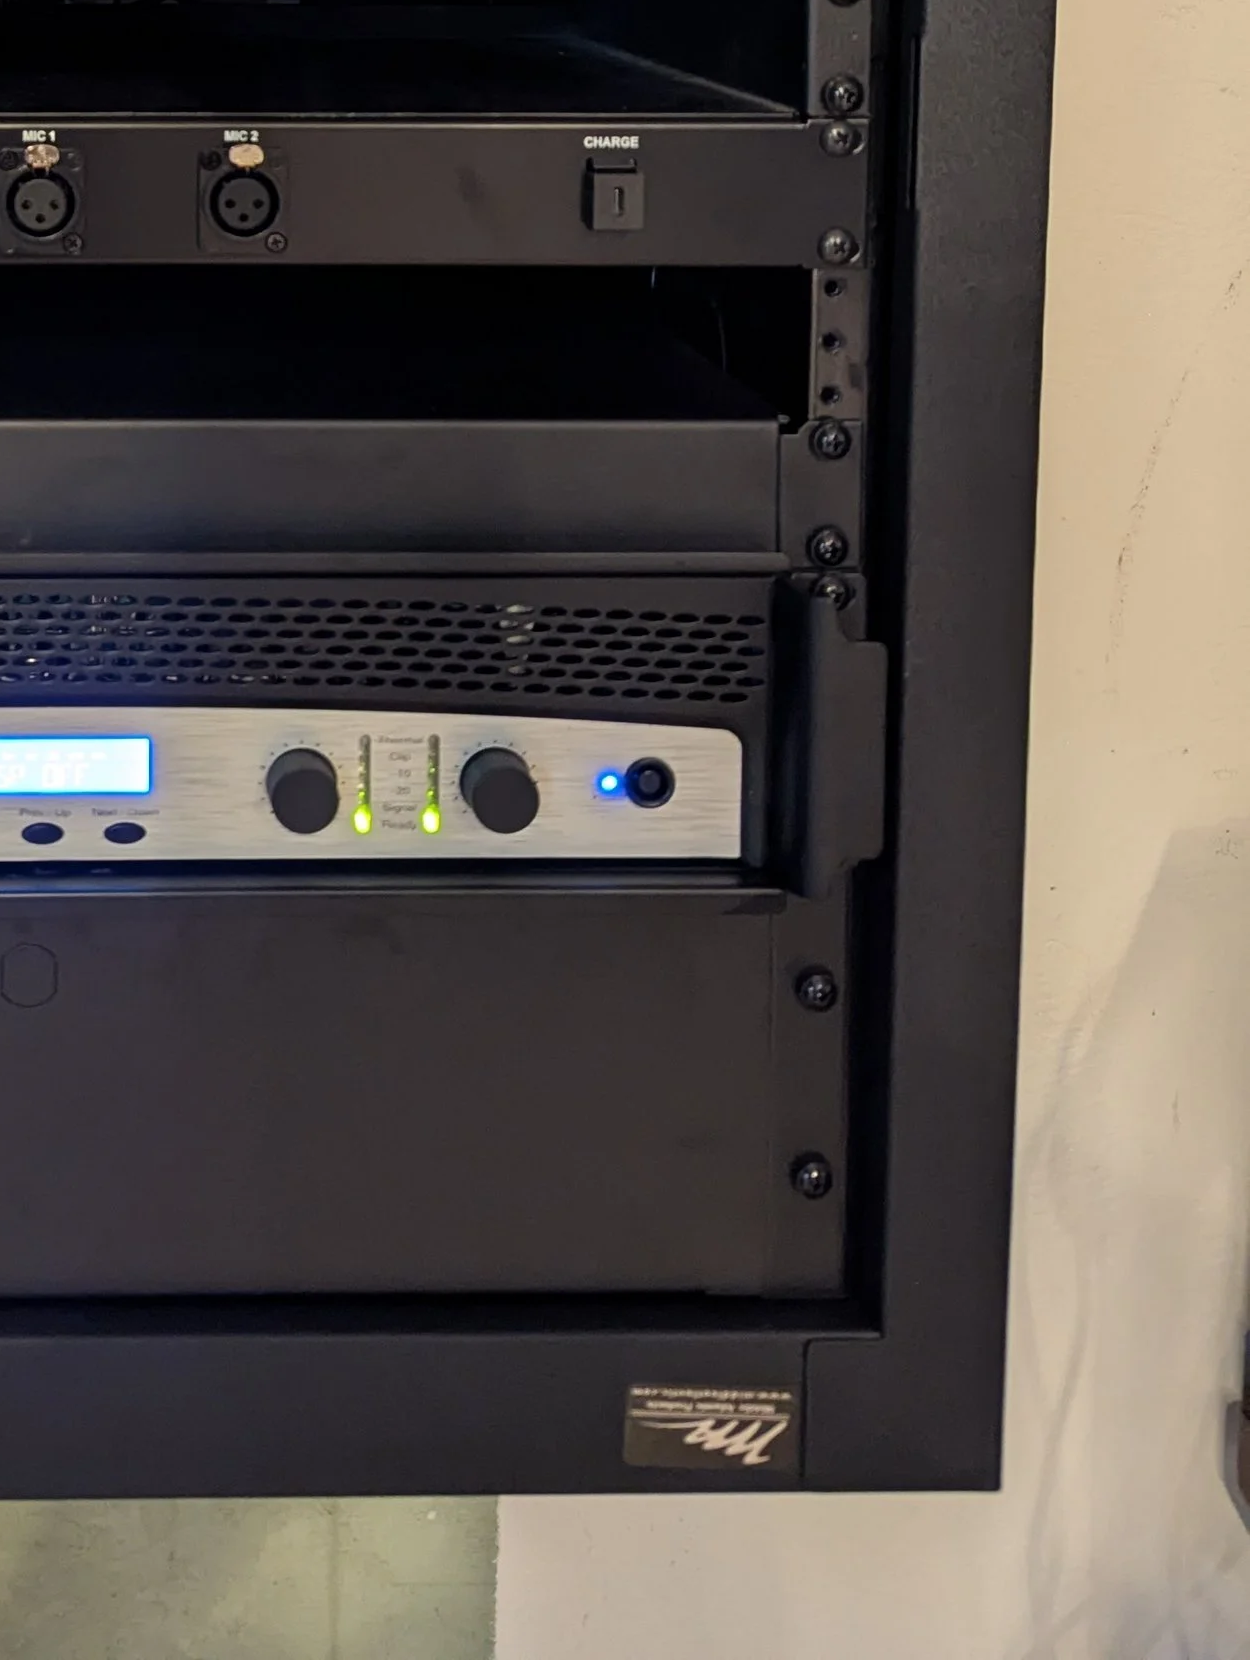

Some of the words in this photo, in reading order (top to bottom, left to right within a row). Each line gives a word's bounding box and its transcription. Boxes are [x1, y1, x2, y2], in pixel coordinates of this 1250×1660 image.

[22, 130, 47, 142] MIC
[48, 130, 56, 142] 1
[224, 130, 247, 142] MIC
[250, 130, 259, 142] 2
[583, 135, 639, 149] CHARGE
